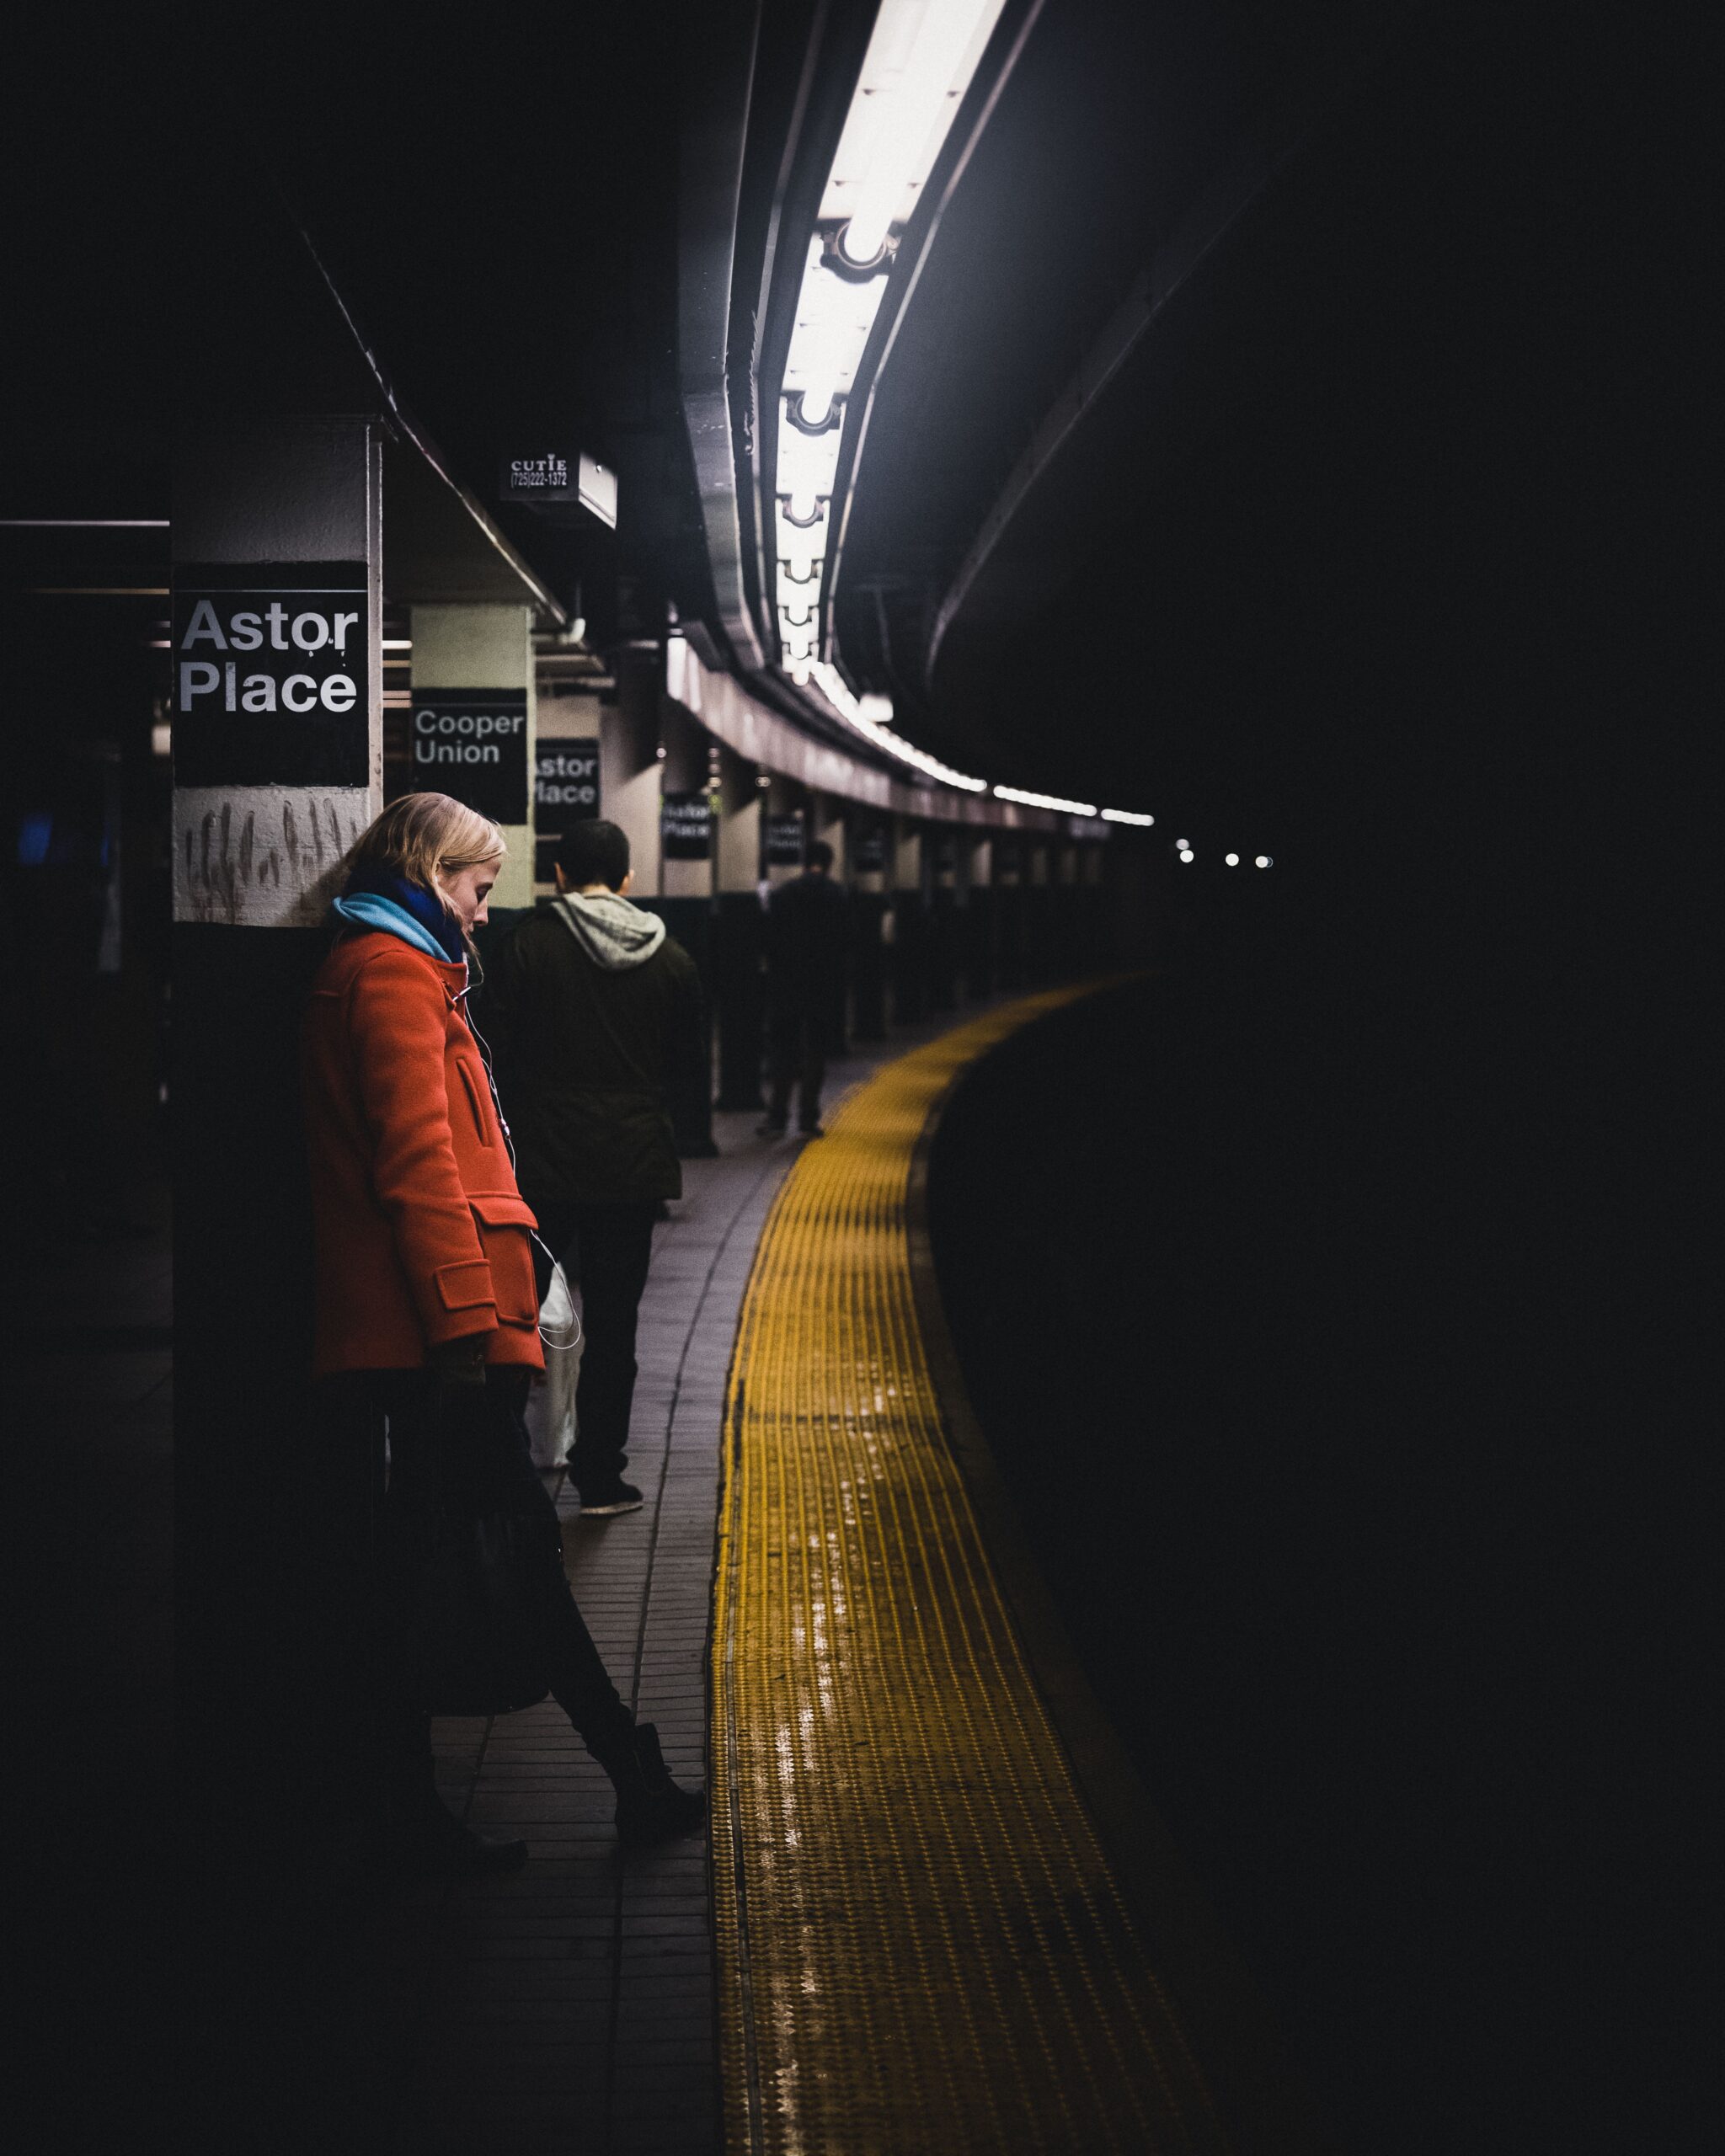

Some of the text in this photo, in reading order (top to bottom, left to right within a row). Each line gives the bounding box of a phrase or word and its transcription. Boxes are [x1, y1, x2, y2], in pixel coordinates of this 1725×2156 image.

[510, 454, 567, 472] CUTIE
[180, 599, 359, 651] Astor
[179, 661, 357, 712] Place
[415, 710, 524, 739] Cooper
[415, 739, 500, 764] Union
[537, 755, 597, 778] stor
[537, 780, 596, 804] lace
